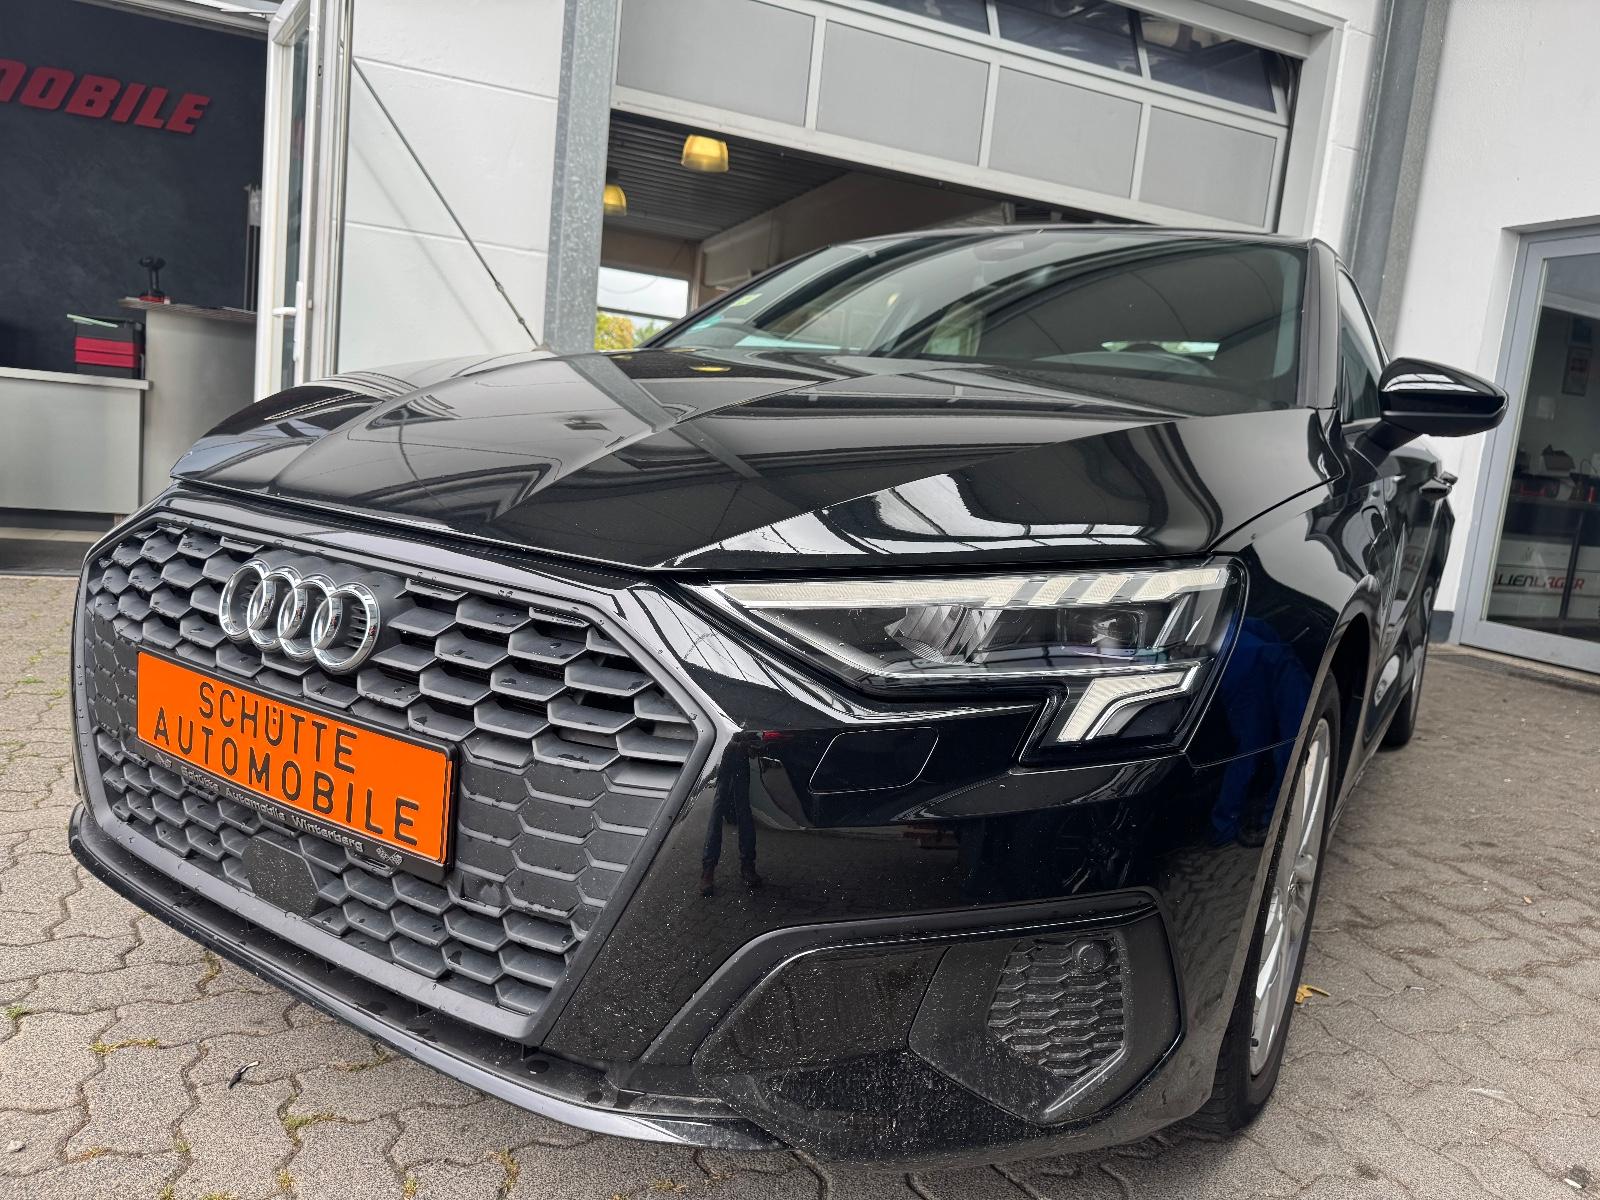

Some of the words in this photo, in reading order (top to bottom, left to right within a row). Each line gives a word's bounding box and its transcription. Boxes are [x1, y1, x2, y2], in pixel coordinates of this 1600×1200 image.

[199, 681, 358, 774] SCHÜTTE
[153, 706, 419, 847] AUTOMOBILE
[225, 787, 286, 821] Automobile
[291, 814, 364, 853] Winterberg
